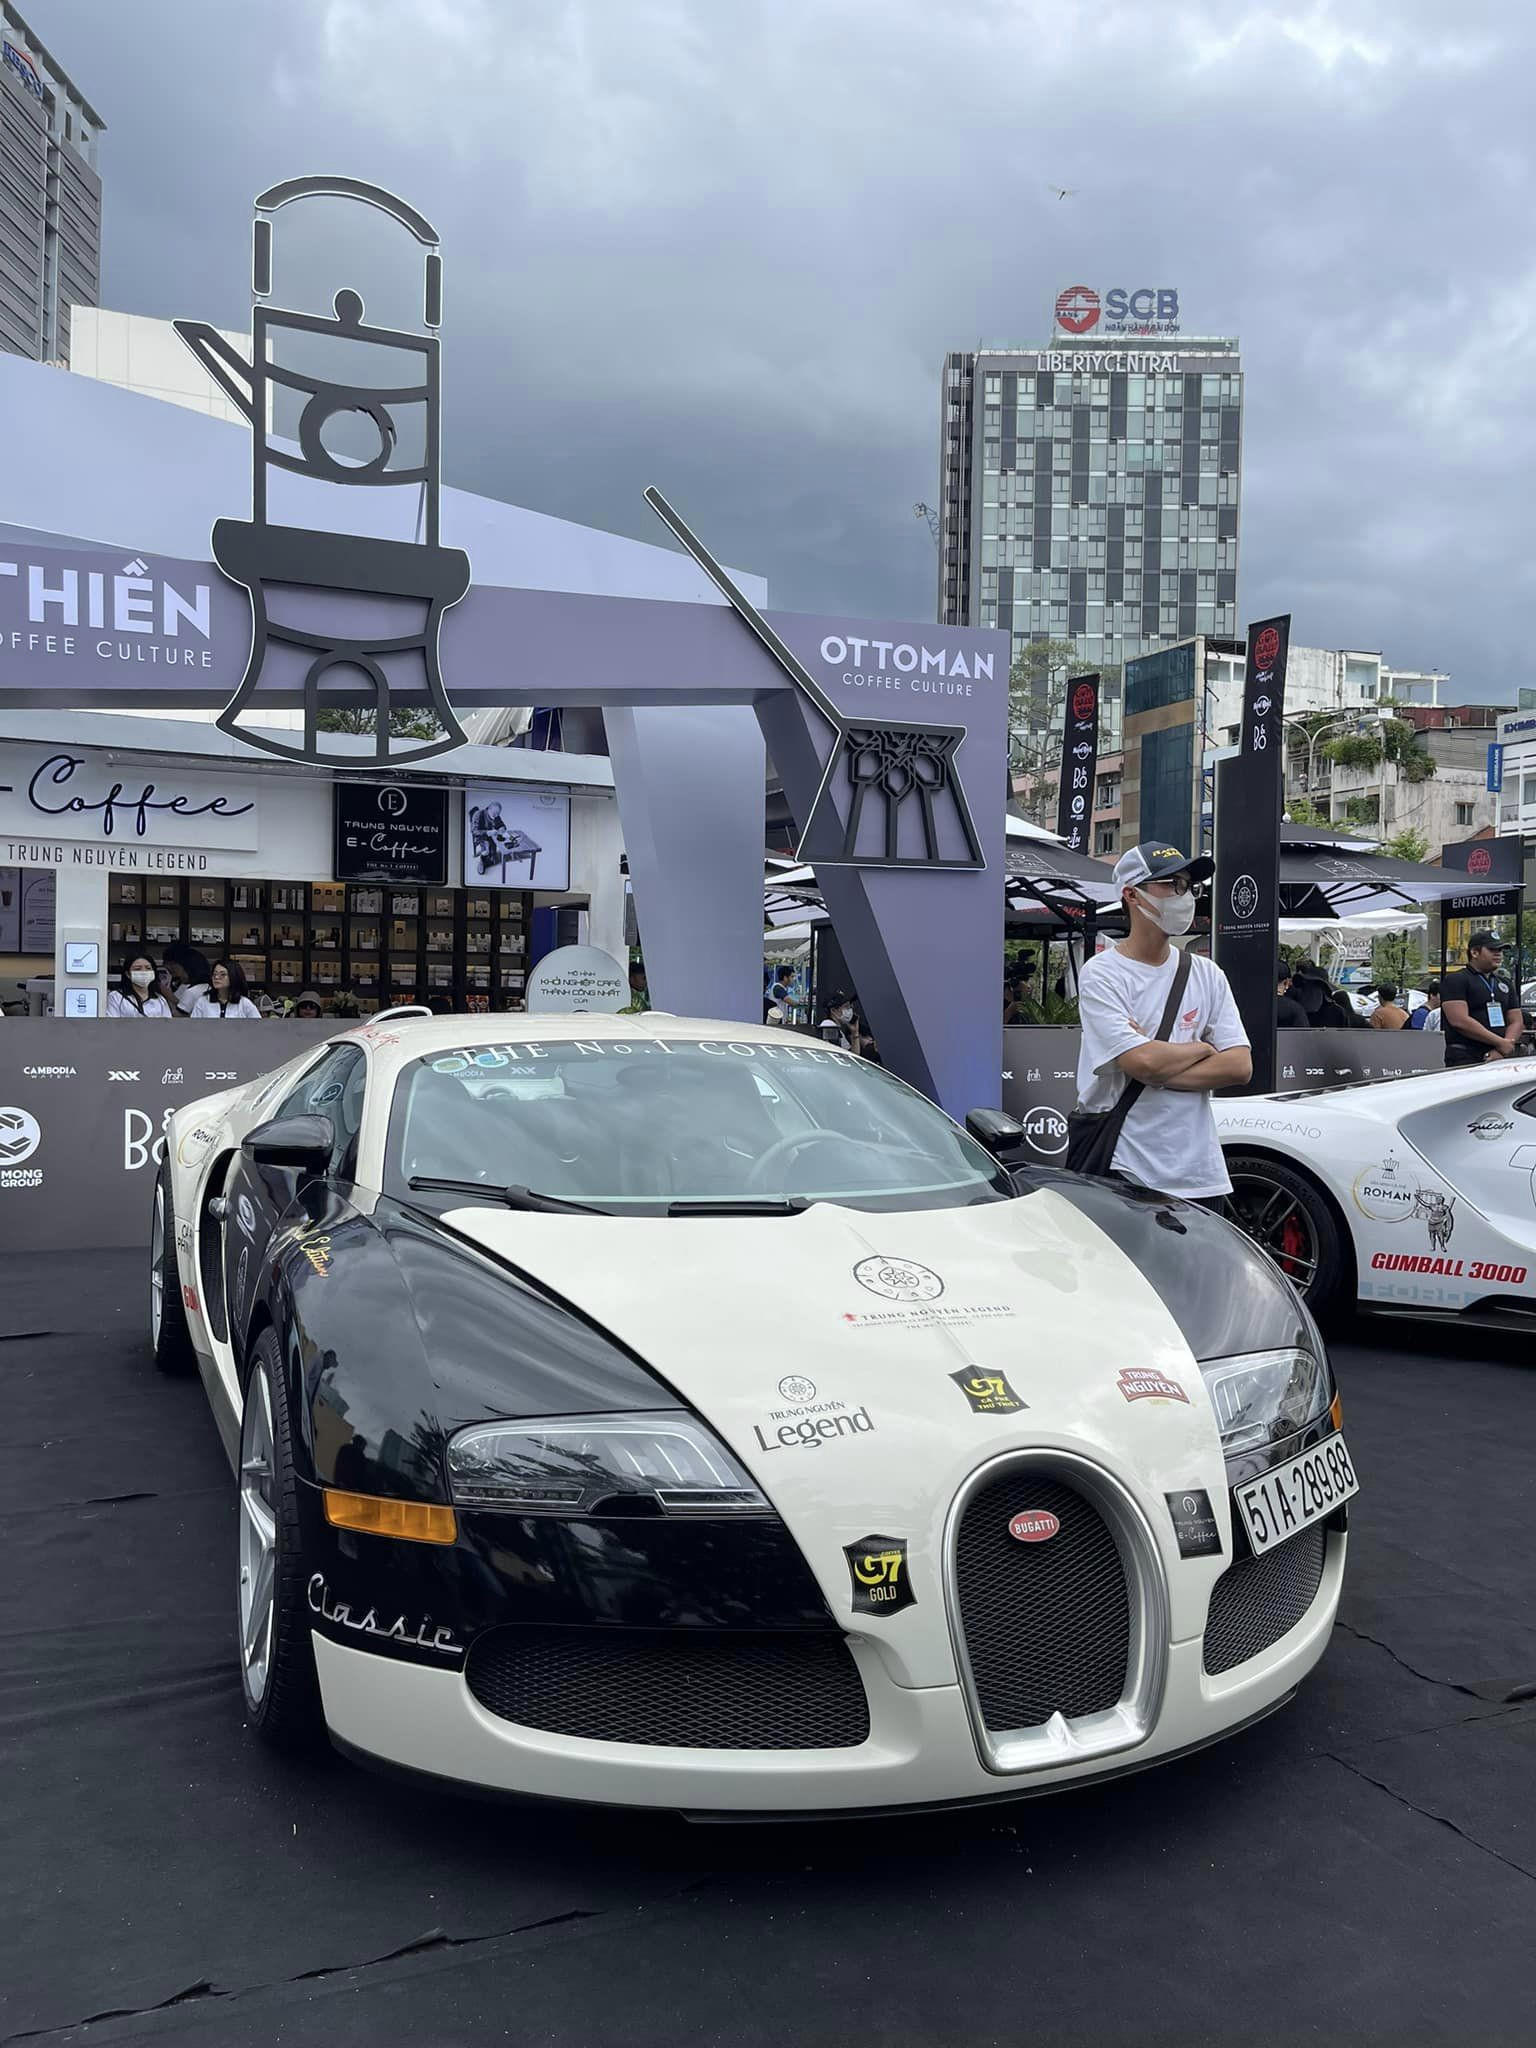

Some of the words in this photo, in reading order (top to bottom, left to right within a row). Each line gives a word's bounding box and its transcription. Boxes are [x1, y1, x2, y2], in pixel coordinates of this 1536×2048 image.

[1105, 288, 1179, 321] SCB
[1037, 352, 1102, 373] LIBERTY
[1104, 353, 1182, 373] CENTRAL
[96, 640, 212, 668] CULTURE
[820, 635, 995, 681] OTTOMAN
[842, 673, 902, 690] COFFEE
[911, 679, 973, 697] CULTURE
[344, 820, 386, 830] TRUNG
[8, 844, 64, 863] TRUNG
[72, 847, 138, 867] NGUYÊN
[147, 852, 208, 871] LEGEND
[1451, 893, 1507, 909] ENTRANCE
[453, 1043, 549, 1066] THE
[23, 1066, 77, 1075] CAMBODIA
[1217, 1117, 1322, 1139] AMERICANO
[1, 1169, 44, 1180] MONG
[1, 1178, 43, 1188] GROUP
[1363, 1186, 1411, 1201] ROMAN
[1371, 1252, 1464, 1277] GUMBALL
[1468, 1261, 1528, 1285] 3000
[861, 1310, 906, 1321] TRUNG
[962, 1304, 1011, 1313] LEGEND
[1125, 1370, 1161, 1381] TRUNG
[963, 1376, 1006, 1398] G7
[1121, 1380, 1183, 1396] NGUYEN
[768, 1406, 805, 1422] TRUNG
[804, 1400, 846, 1416] NGUYÊN
[753, 1405, 876, 1452] Legend
[1242, 1440, 1355, 1544] 51A-289.88
[1014, 1518, 1056, 1535] BUGATTI
[854, 1553, 903, 1585] G7
[869, 1585, 897, 1602] GOLD
[307, 1572, 464, 1654] Classic
